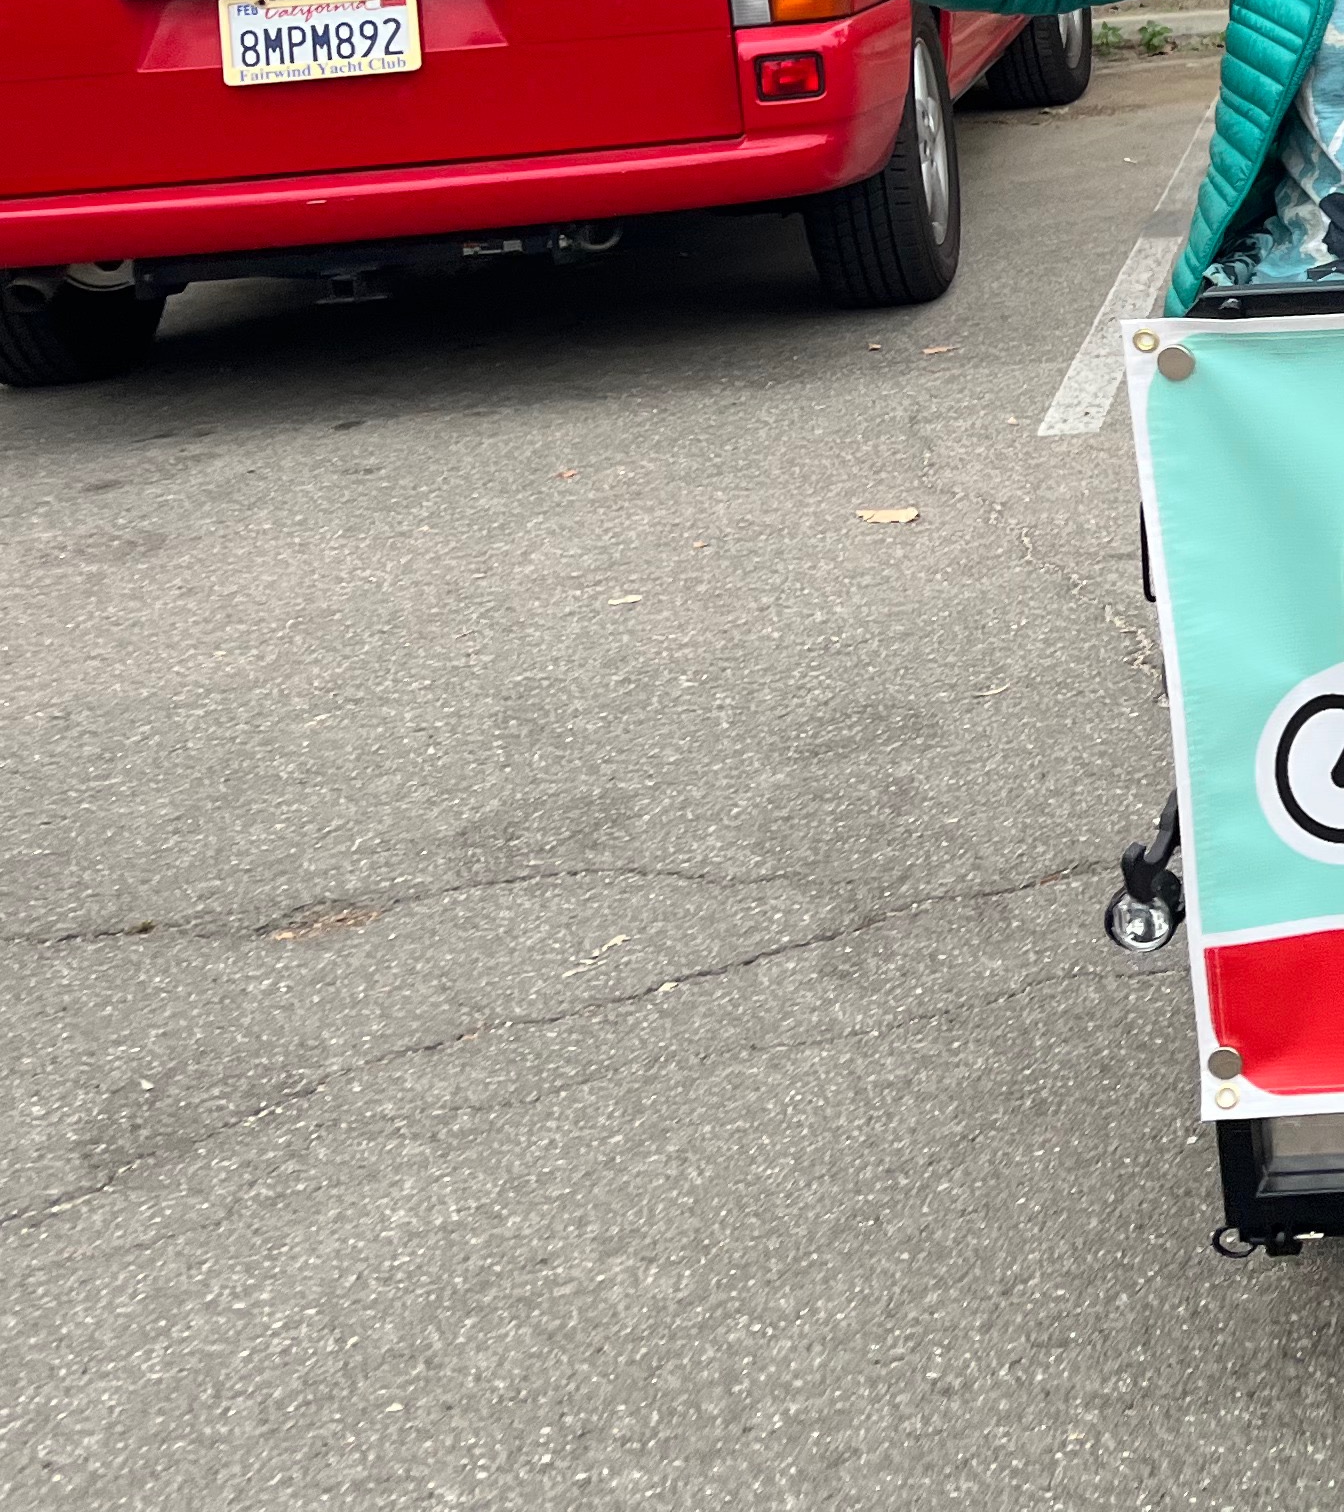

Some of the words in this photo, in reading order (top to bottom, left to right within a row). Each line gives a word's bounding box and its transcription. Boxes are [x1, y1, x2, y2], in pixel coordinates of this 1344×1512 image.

[240, 18, 404, 67] 8MPM892
[240, 64, 311, 82] Fairwind
[317, 60, 363, 75] Yacht
[368, 57, 407, 70] Club
